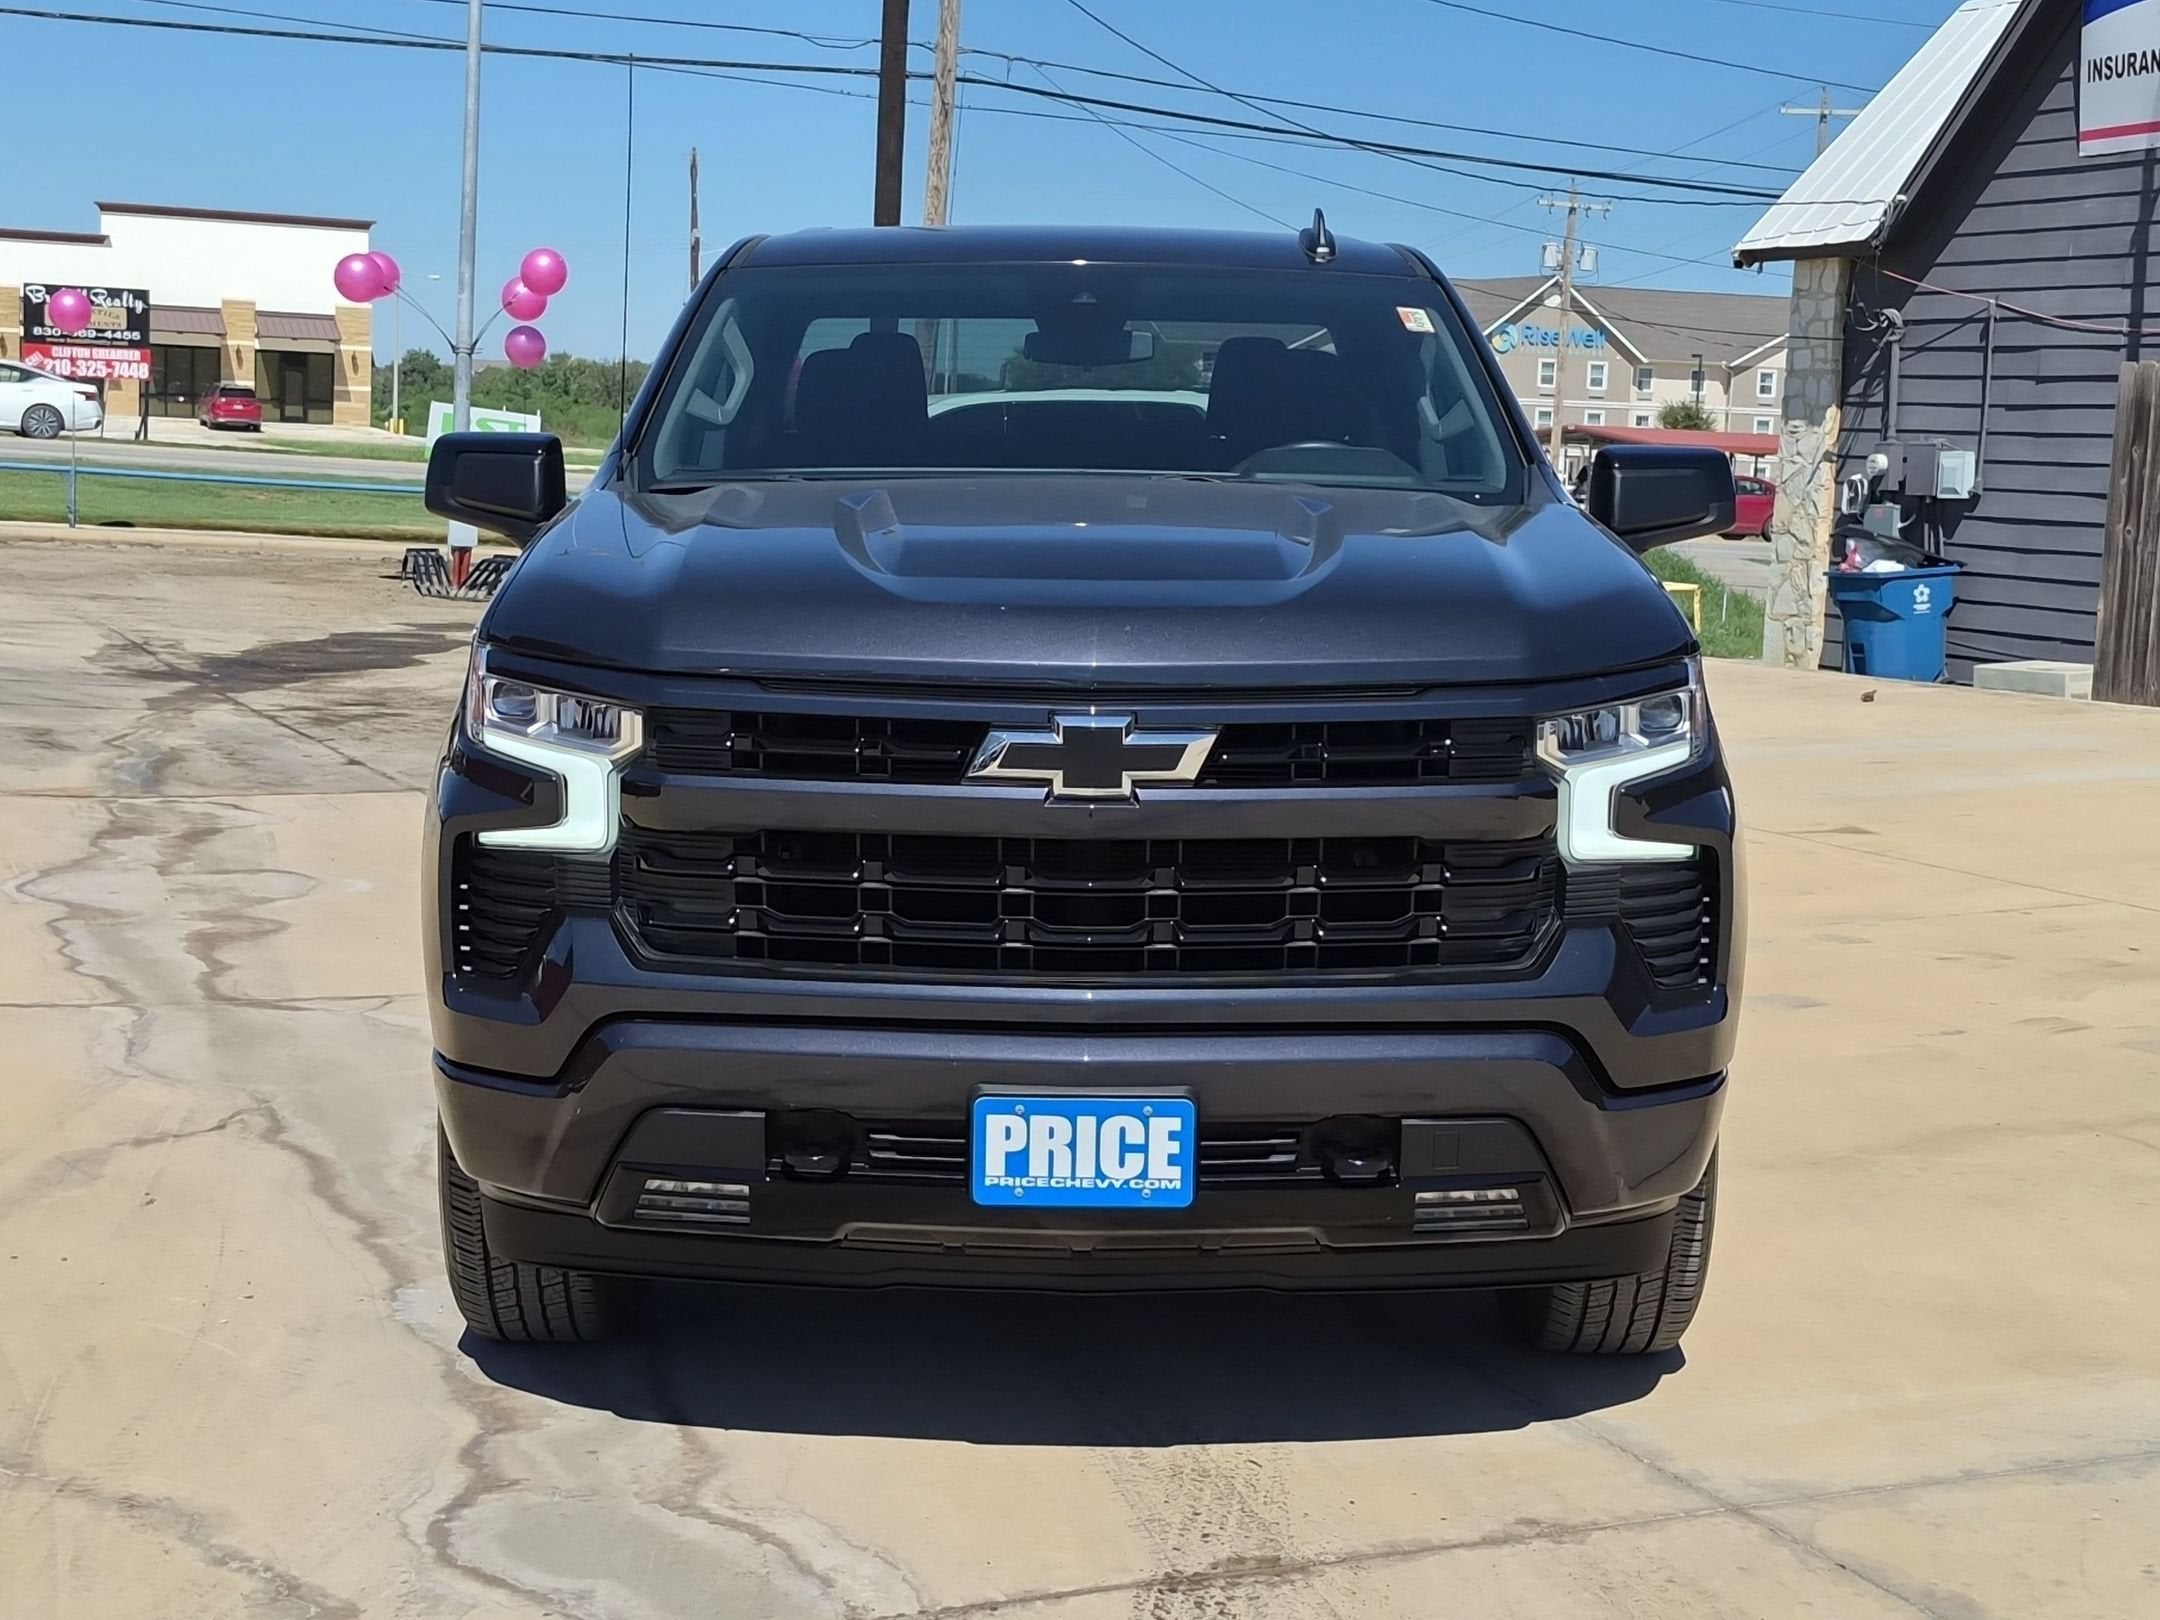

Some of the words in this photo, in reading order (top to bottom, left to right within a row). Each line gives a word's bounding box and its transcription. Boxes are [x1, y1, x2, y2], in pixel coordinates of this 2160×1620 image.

[2087, 48, 2160, 83] INSURAN
[89, 288, 149, 314] Realty
[32, 326, 141, 341] 830-69-4455
[985, 1114, 1182, 1178] PRICE
[984, 1176, 1182, 1189] PRICECHEVY.COM
